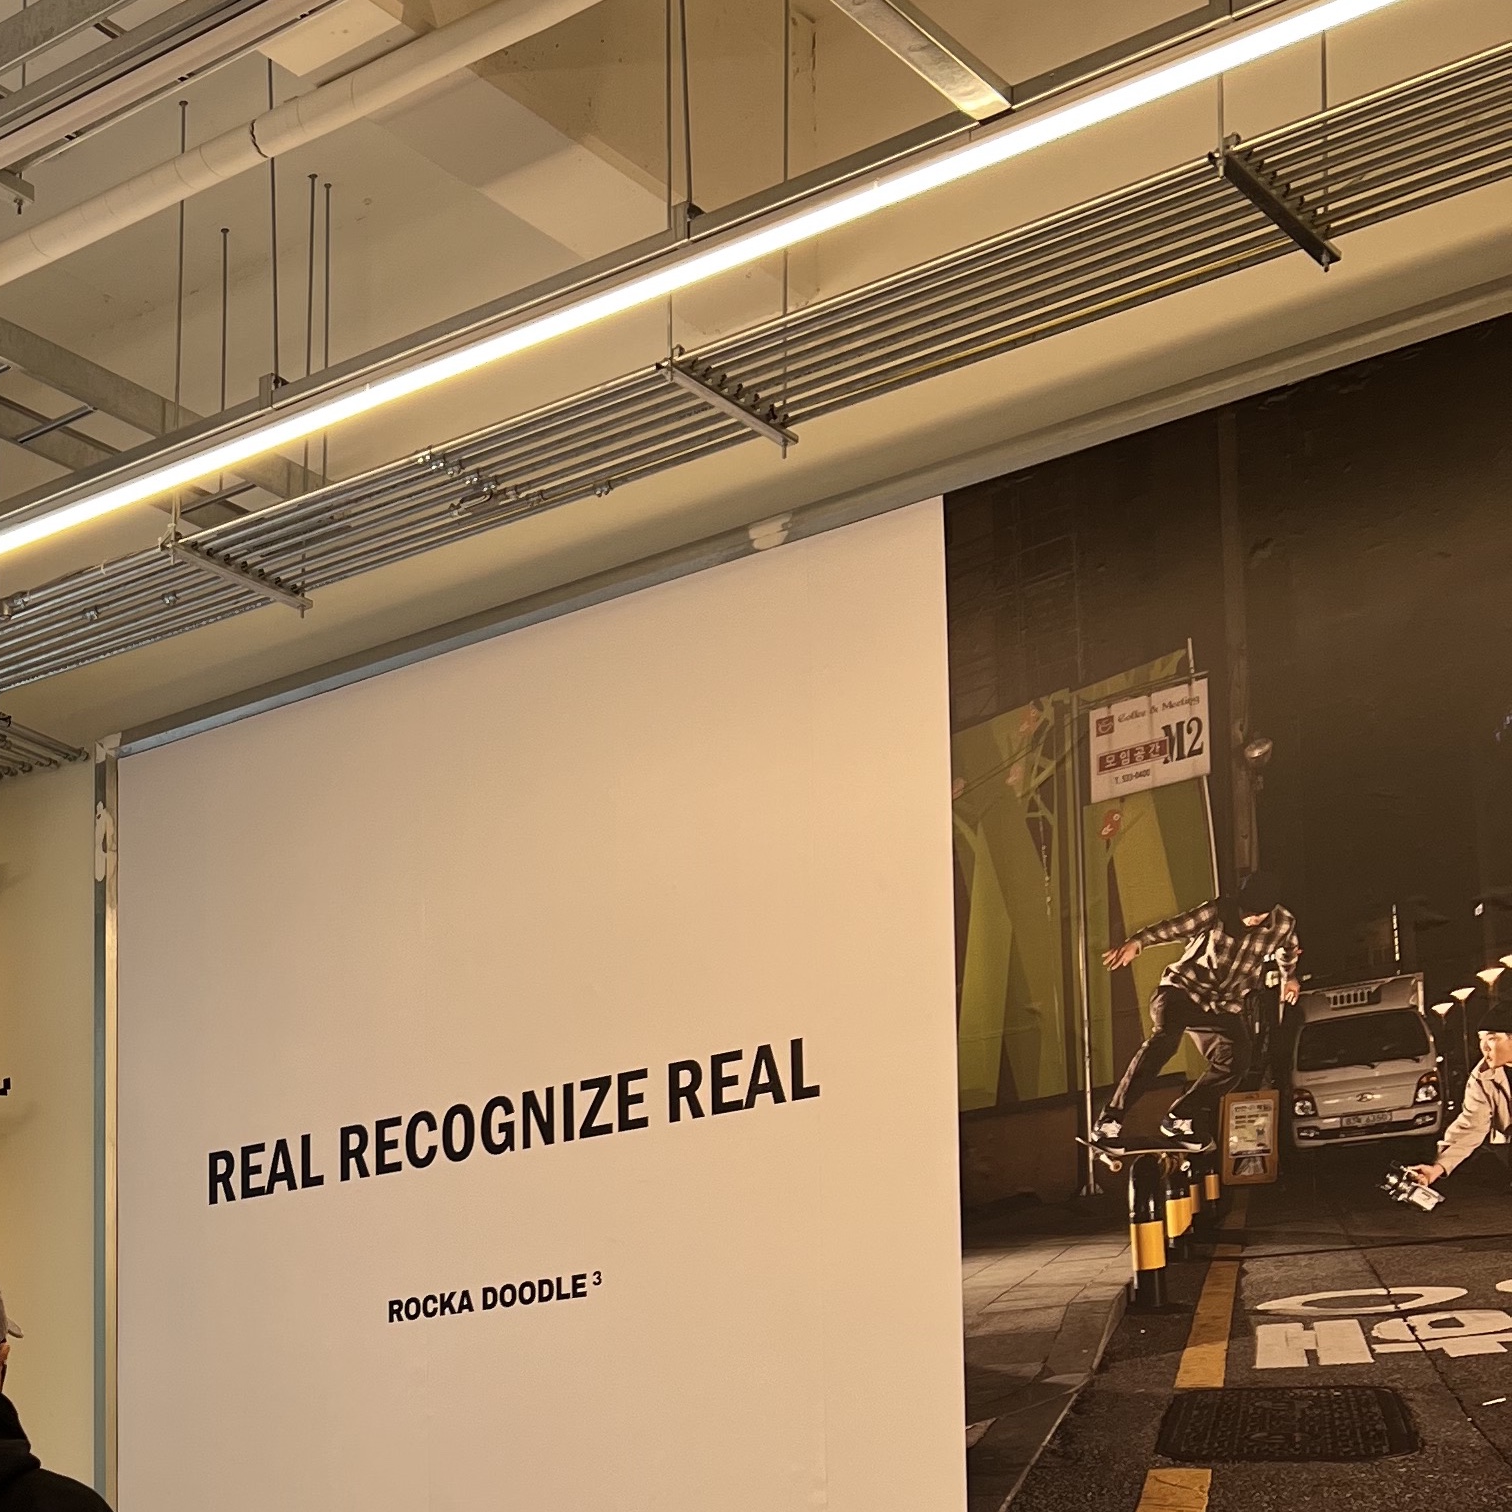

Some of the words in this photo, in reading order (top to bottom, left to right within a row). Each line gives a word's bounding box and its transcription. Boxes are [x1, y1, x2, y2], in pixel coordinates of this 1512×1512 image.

[1104, 744, 1161, 769] 모임공간
[208, 1134, 325, 1206] REAL
[339, 1067, 650, 1182] RECOGNIZE
[667, 1037, 821, 1123] REAL
[388, 1290, 474, 1323] ROCKA
